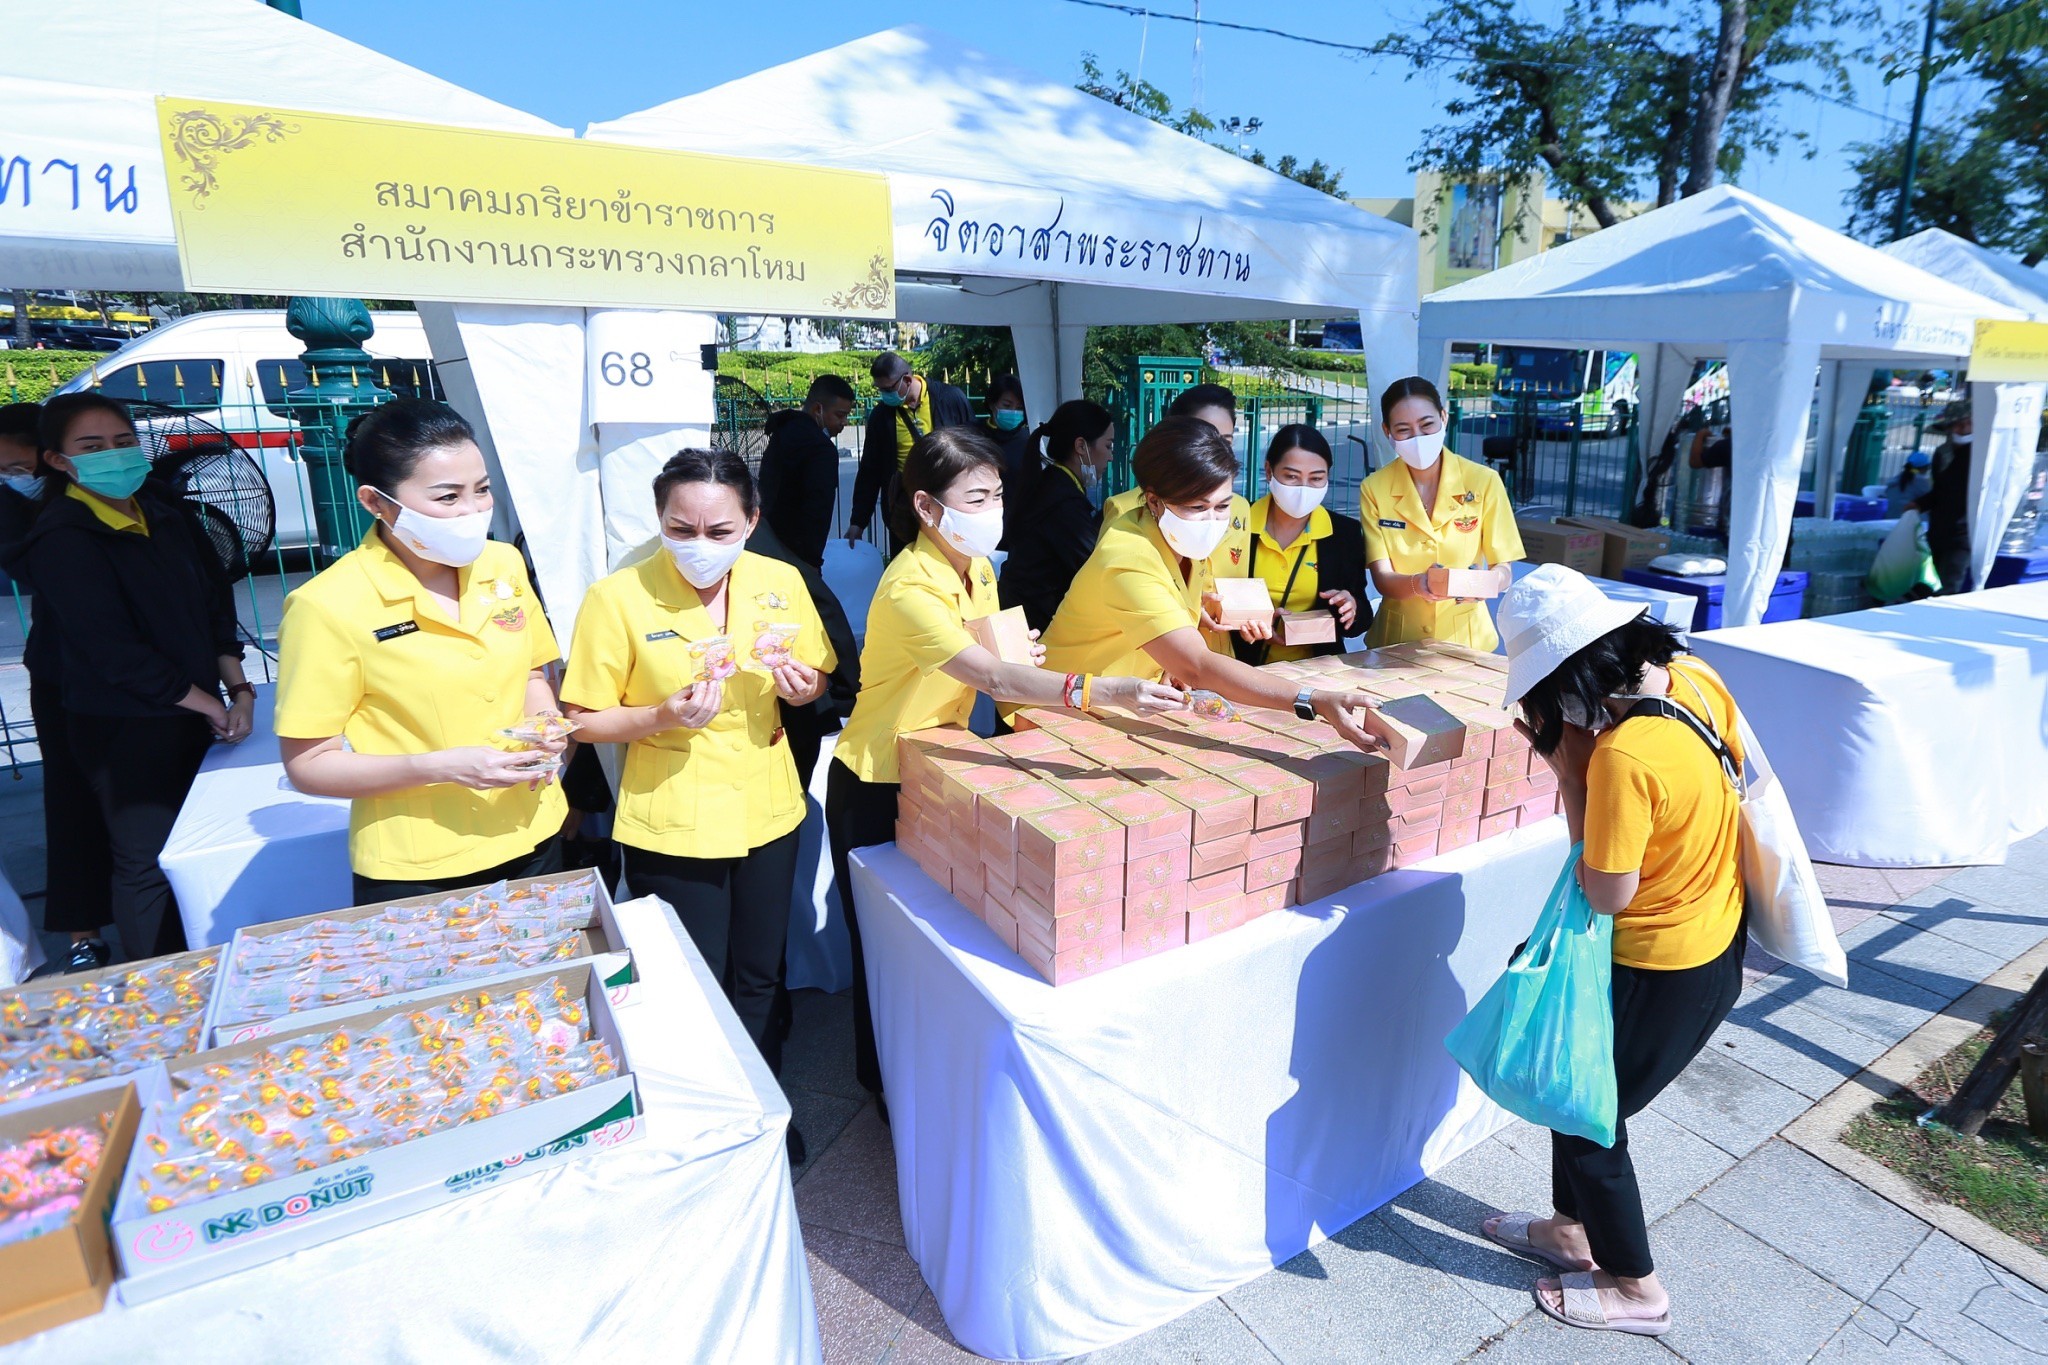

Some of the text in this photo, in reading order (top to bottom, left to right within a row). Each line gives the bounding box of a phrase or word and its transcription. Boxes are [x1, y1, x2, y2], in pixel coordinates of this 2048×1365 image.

[375, 181, 776, 235] สมาคมภริยาข้าราชการ
[924, 188, 1251, 283] จิตอาสาพระราชทาน
[342, 223, 806, 283] สำนักงานกระทรวงกลาโหม
[601, 351, 654, 387] 68
[205, 1210, 255, 1241] NK
[261, 1175, 371, 1224] DONUT
